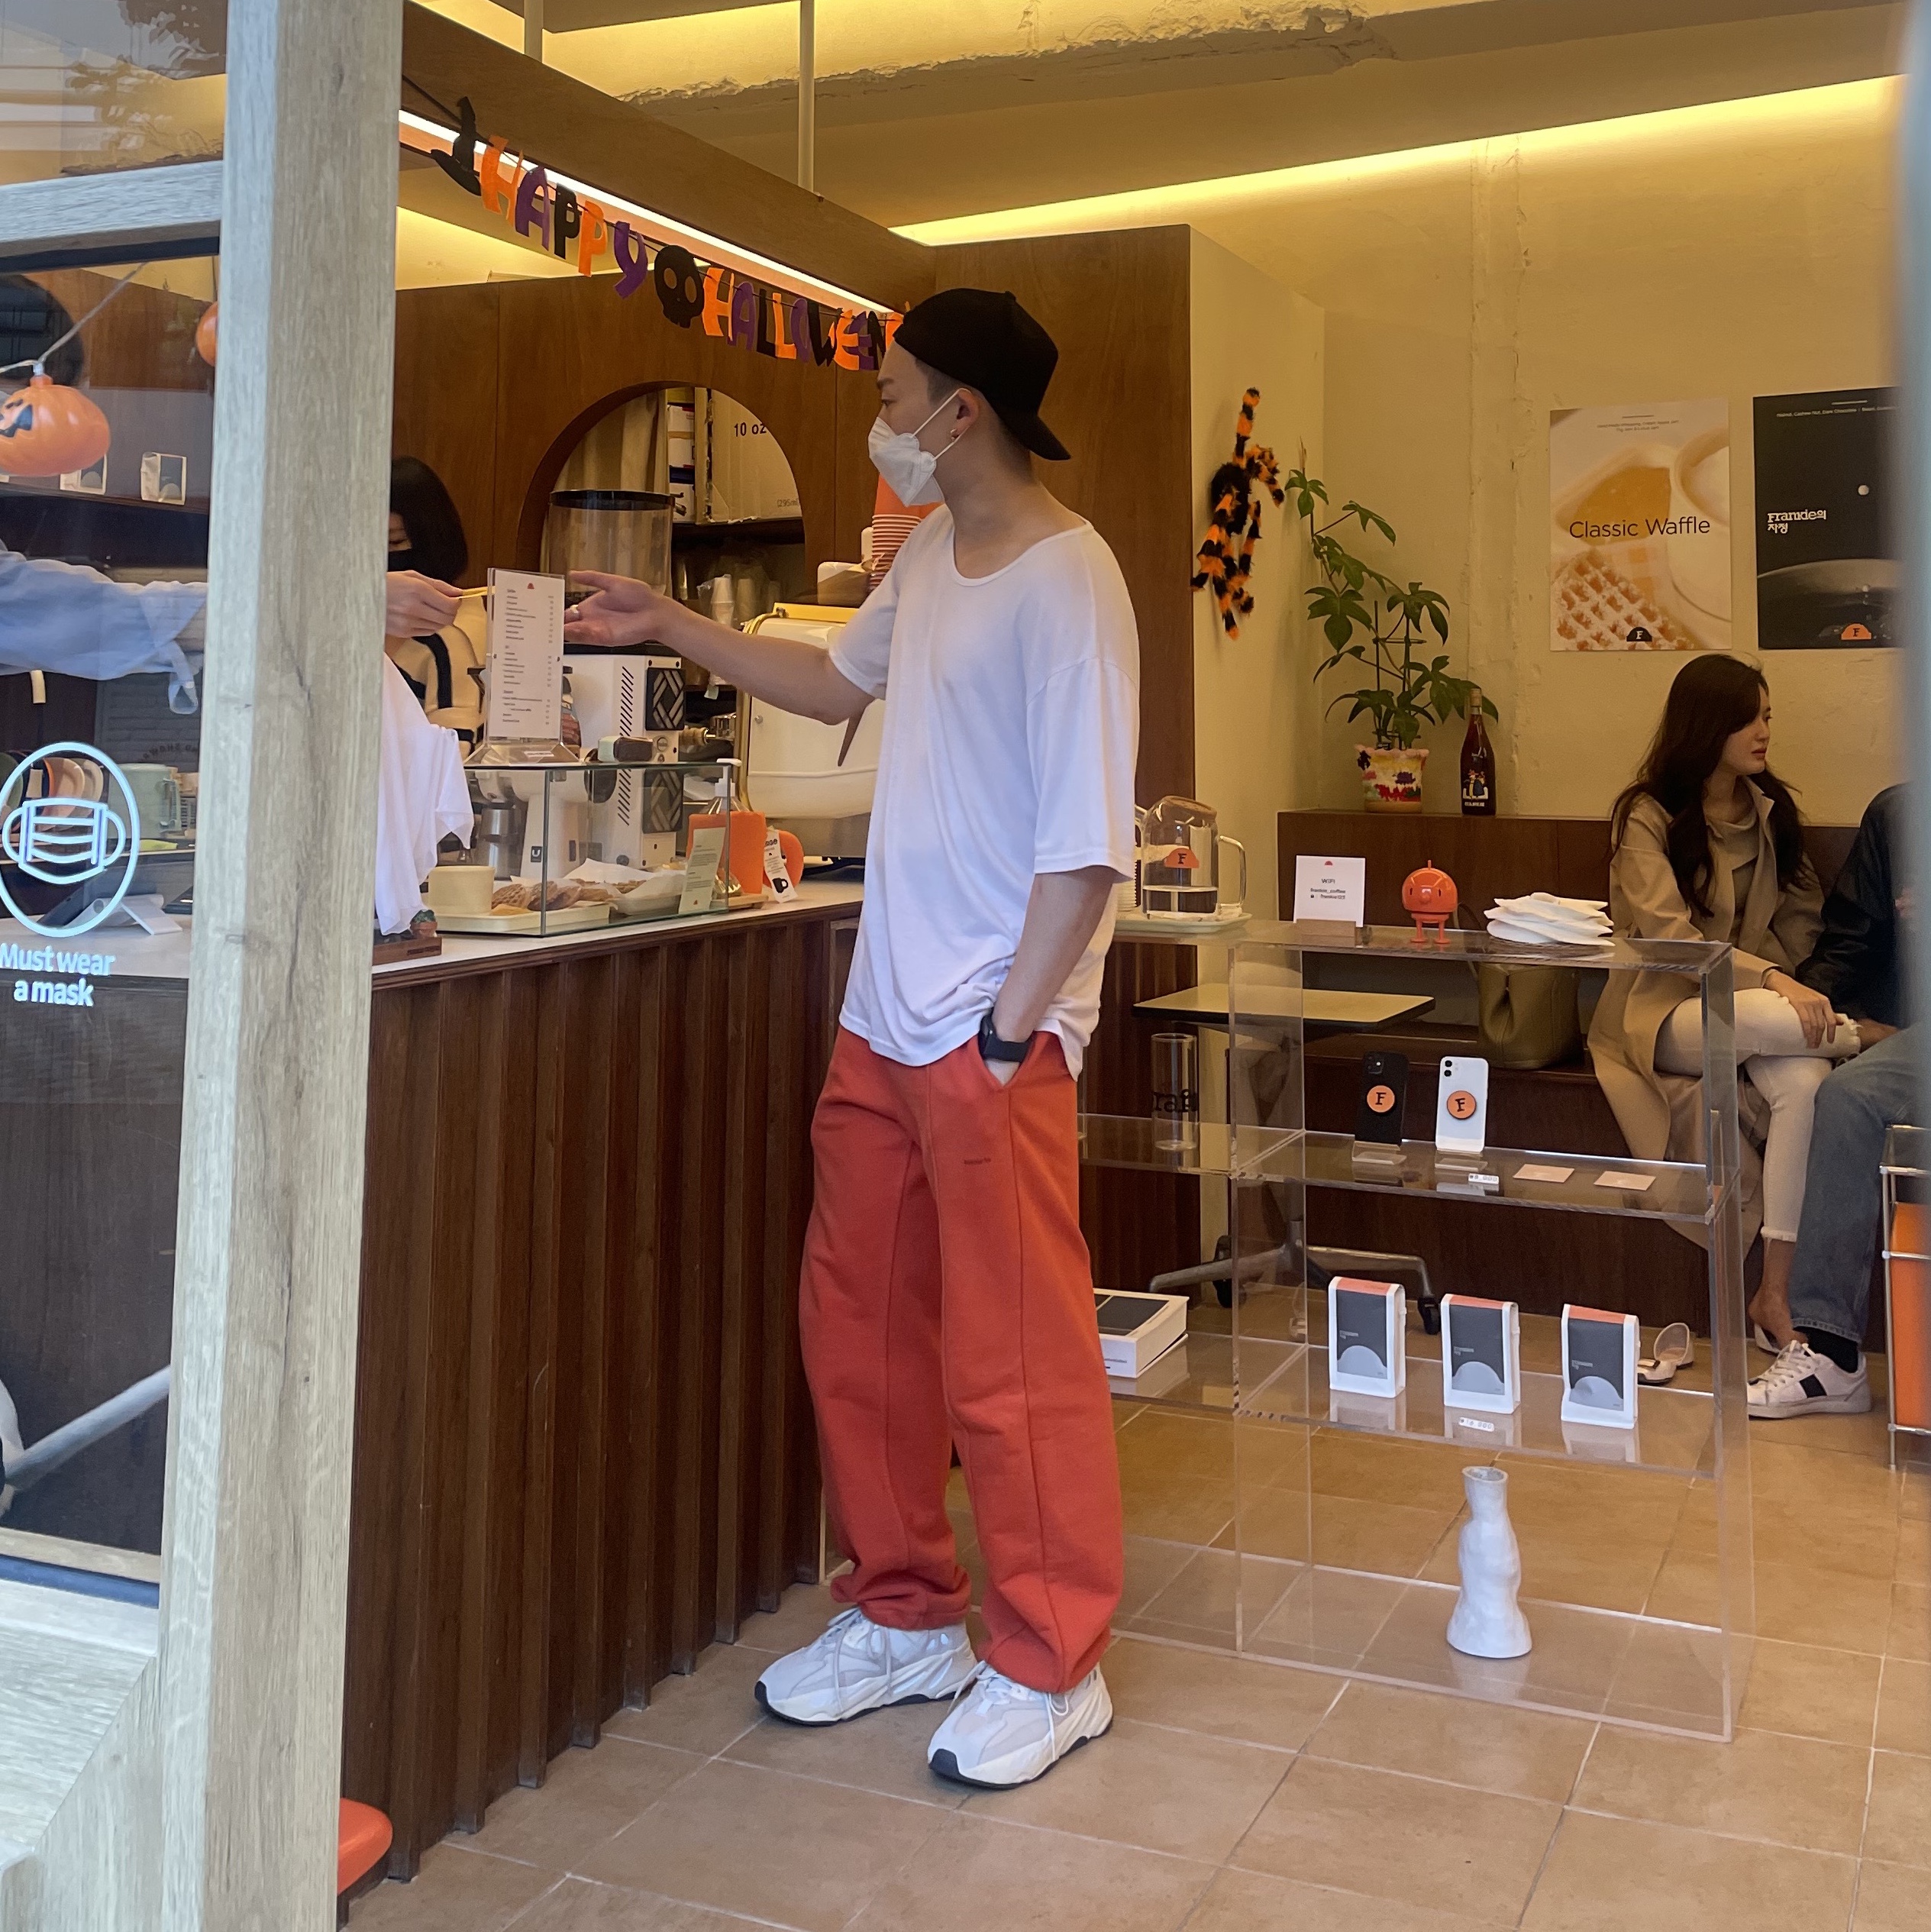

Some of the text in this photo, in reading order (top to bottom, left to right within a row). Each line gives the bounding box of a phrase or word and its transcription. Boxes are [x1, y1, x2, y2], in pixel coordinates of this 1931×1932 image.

[479, 134, 649, 300] HAPPY
[734, 422, 767, 438] 10 oz
[1569, 515, 1710, 538] Classic Waffle
[1636, 630, 1644, 640] F
[1852, 628, 1861, 638] F
[1177, 852, 1187, 865] F
[0, 942, 117, 976] Must wear
[13, 977, 95, 1007] a mask
[1375, 1091, 1387, 1106] F
[1455, 1097, 1466, 1113] F
